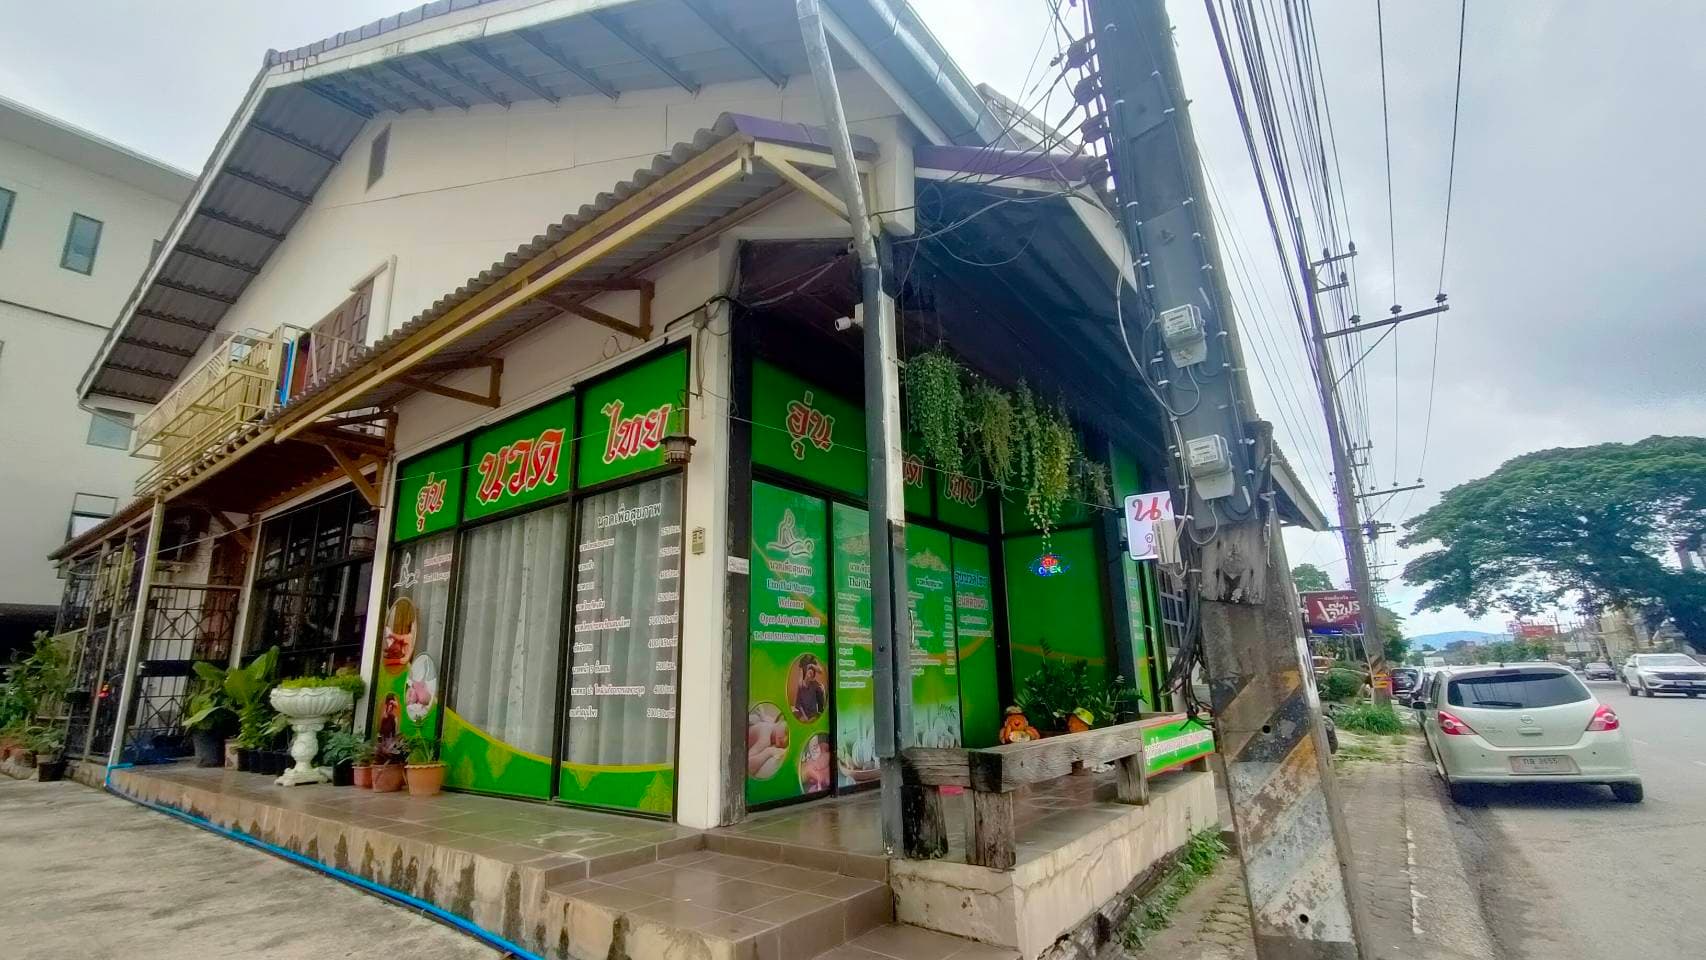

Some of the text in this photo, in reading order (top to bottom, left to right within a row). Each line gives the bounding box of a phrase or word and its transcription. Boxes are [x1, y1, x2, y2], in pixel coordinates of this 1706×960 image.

[601, 398, 672, 464] ไทย
[785, 391, 836, 461] อุ่น
[476, 428, 566, 506] นวด
[415, 472, 447, 533] อุ่น
[597, 501, 662, 529] นวดเพื่อสุขภาพ
[777, 596, 805, 609] Welcome
[848, 576, 872, 590] Thai Ma
